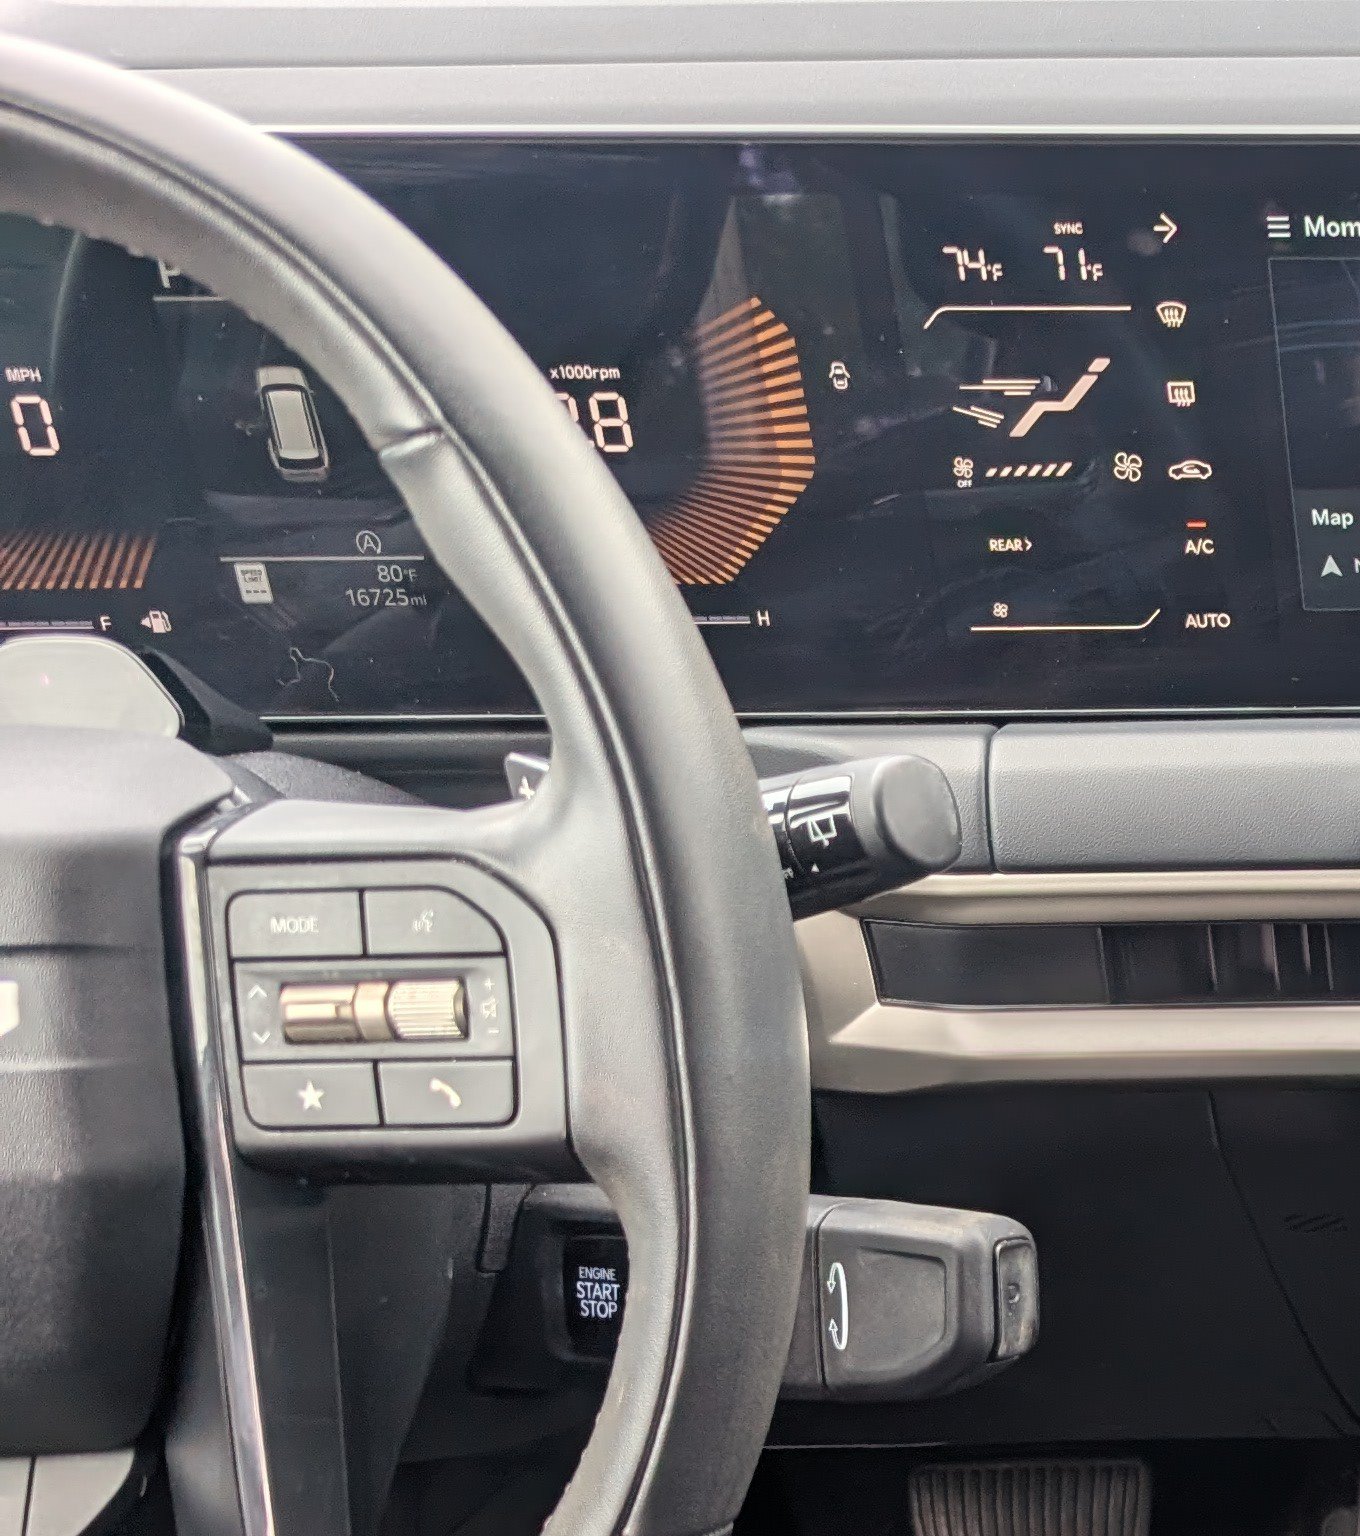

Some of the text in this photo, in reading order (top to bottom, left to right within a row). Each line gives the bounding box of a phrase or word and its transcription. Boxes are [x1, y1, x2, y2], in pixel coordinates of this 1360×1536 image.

[1053, 221, 1084, 235] SYNC
[4, 365, 43, 383] MPH
[549, 363, 621, 381] x1000rpm
[10, 395, 61, 457] 0
[956, 479, 973, 489] OFF
[1311, 507, 1355, 530] Map
[989, 537, 1024, 552] REAR
[1185, 538, 1216, 555] A/C
[99, 614, 112, 632] F
[757, 610, 772, 628] H
[1185, 612, 1232, 630] AUTO
[270, 916, 320, 934] MODE
[578, 1265, 618, 1282] ENGINE
[576, 1280, 621, 1302] START
[580, 1299, 619, 1319] STOP
